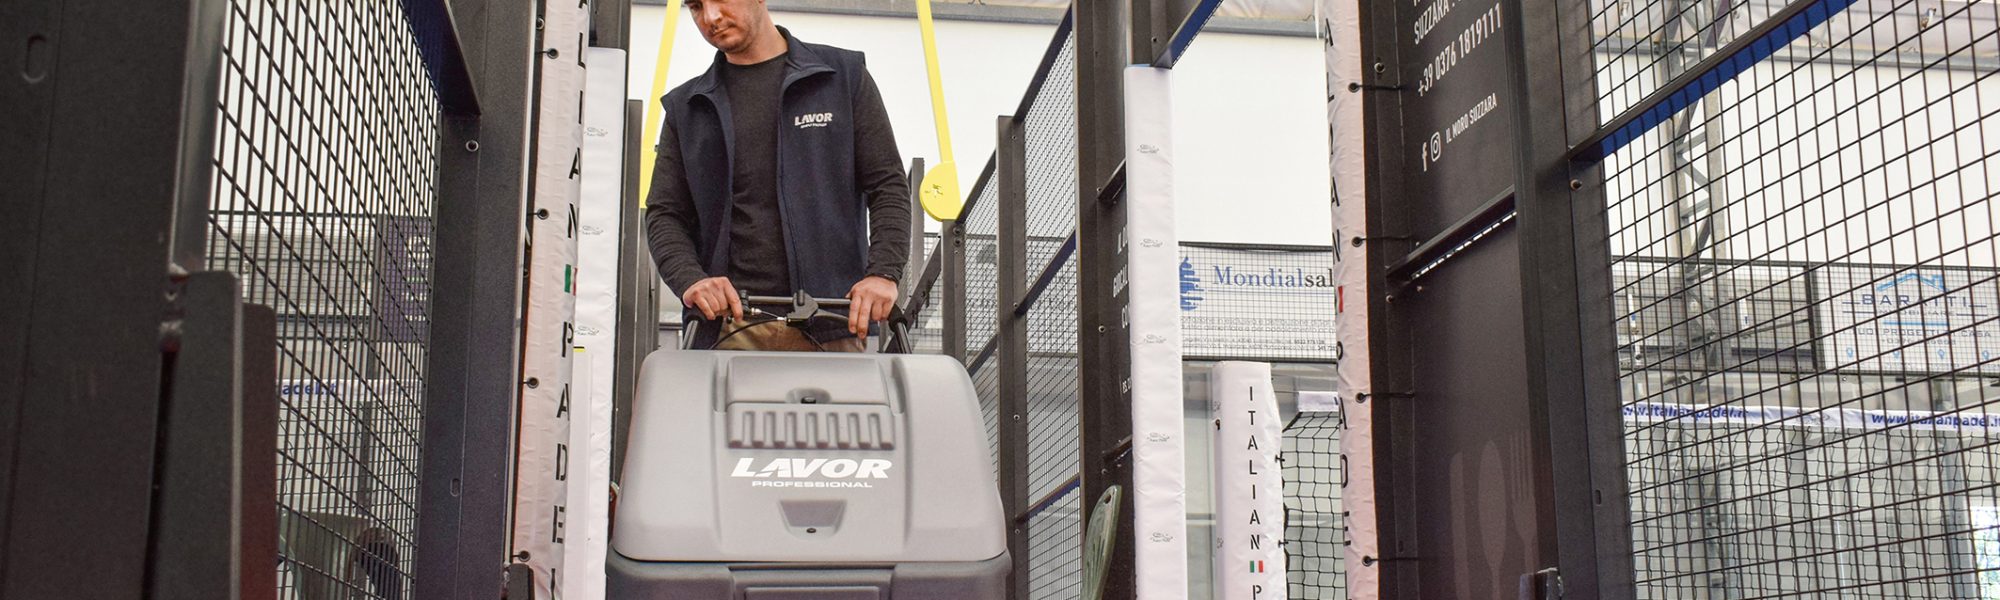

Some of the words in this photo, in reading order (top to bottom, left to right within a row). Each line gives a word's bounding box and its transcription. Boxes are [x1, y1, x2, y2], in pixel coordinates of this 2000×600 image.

[1418, 63, 1434, 97] +39
[1434, 41, 1457, 81] 0376
[1458, 2, 1502, 59] 1819111
[794, 112, 833, 126] LAVOR
[1452, 113, 1470, 139] MORO
[1469, 92, 1498, 125] SUZZARA
[730, 457, 893, 479] LAVOR
[751, 480, 873, 488] PROFESSIONAL
[1247, 386, 1261, 550] ITALIAN
